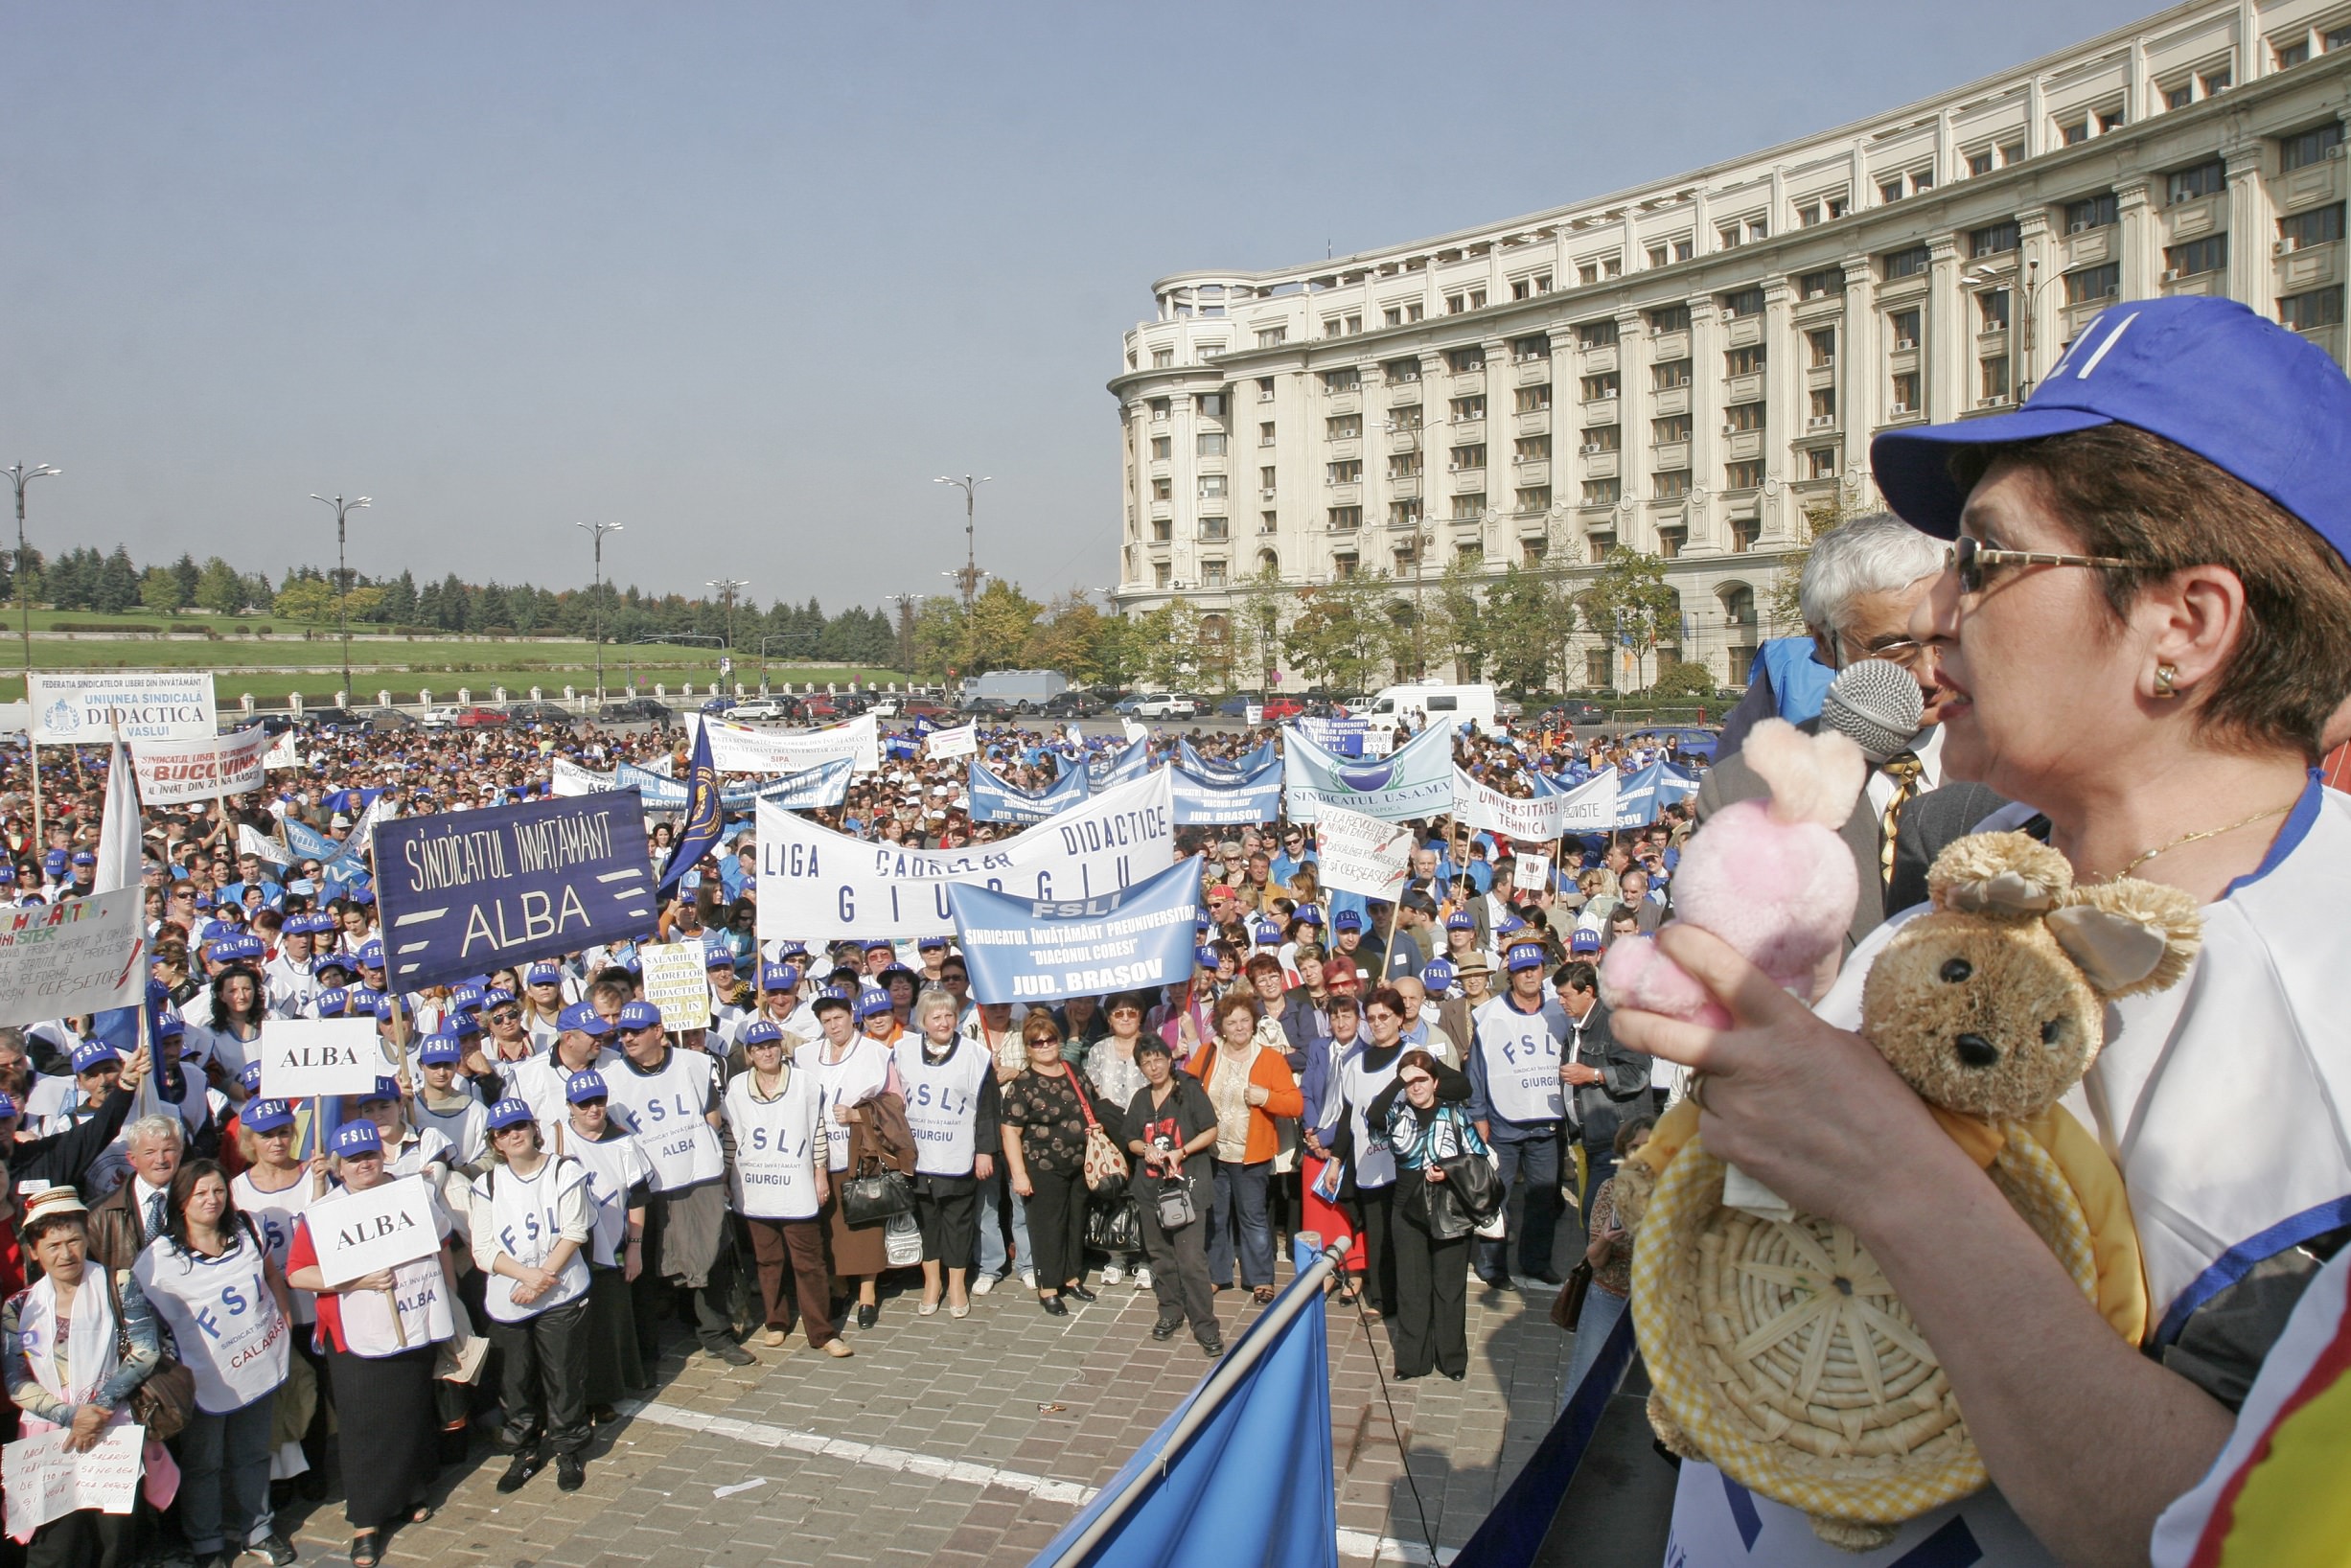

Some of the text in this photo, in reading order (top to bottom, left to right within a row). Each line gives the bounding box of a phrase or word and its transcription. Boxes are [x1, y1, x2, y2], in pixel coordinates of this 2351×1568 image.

[78, 680, 123, 688] SINDICATELOR
[84, 690, 202, 704] UNIUNEA SINDICALĂ
[87, 706, 204, 725] DIDACTICA
[127, 726, 169, 737] VASLUI
[193, 751, 215, 762] LIBER
[188, 781, 204, 792] DIN
[208, 776, 232, 788] ZONA
[1294, 791, 1377, 805] SINDICATUL
[1479, 791, 1558, 817] UNIVERSITATEA
[992, 810, 1014, 819] JUD.
[1189, 809, 1261, 822] JUD. BRAȘOV
[1617, 813, 1642, 828] ȘOV
[765, 843, 819, 878] LIGA
[1060, 805, 1167, 856] DIDACTICE
[405, 811, 611, 892] SINDICATUL ÎNVĂȚĂMÂNT
[1032, 893, 1120, 918] FSLI
[313, 914, 331, 925] FSLI
[461, 885, 591, 958] ALBA
[965, 929, 1028, 945] SINDICATUL
[1030, 923, 1103, 948] ÎNVĂȚĂMÂNT
[1260, 926, 1279, 935] FSLI
[239, 935, 259, 948] FSLI
[1575, 934, 1595, 942] FSLI
[217, 941, 239, 954] FSLI
[781, 943, 797, 957] FSLI
[1514, 948, 1536, 959] FSLI
[646, 953, 701, 965] SALARIILE
[709, 950, 727, 960] FSLI
[535, 965, 555, 975] FSLI
[647, 969, 703, 981] CADRELOR
[768, 967, 789, 980] FSLI
[1013, 958, 1163, 995] JUD. BRAȘOV
[1428, 969, 1447, 978] FSLI
[321, 991, 344, 1007] FSLI
[455, 989, 476, 1004] FSLI
[485, 991, 508, 1005] FSLI
[649, 986, 704, 998] DIDACTICE
[864, 992, 886, 1006] FSLI
[621, 1008, 642, 1020] FSLI
[660, 1004, 680, 1013] UNT
[451, 1014, 475, 1029] FSLI
[668, 1021, 690, 1030] POM
[751, 1023, 775, 1035] FSLI
[77, 1040, 107, 1062] FSLI
[427, 1039, 454, 1052] FSLI
[280, 1047, 359, 1067] ALBA
[572, 1075, 599, 1093] FSLI
[256, 1100, 285, 1118] FSLI
[495, 1099, 524, 1118] FSLI
[340, 1129, 374, 1145] FSLI
[910, 1128, 954, 1141] GIURGIU
[662, 1138, 696, 1158] ALBA
[745, 1173, 791, 1186] GIURGIU
[337, 1209, 416, 1251] ALBA
[398, 1289, 436, 1314] ALBA
[221, 1328, 254, 1349] SINDICAT
